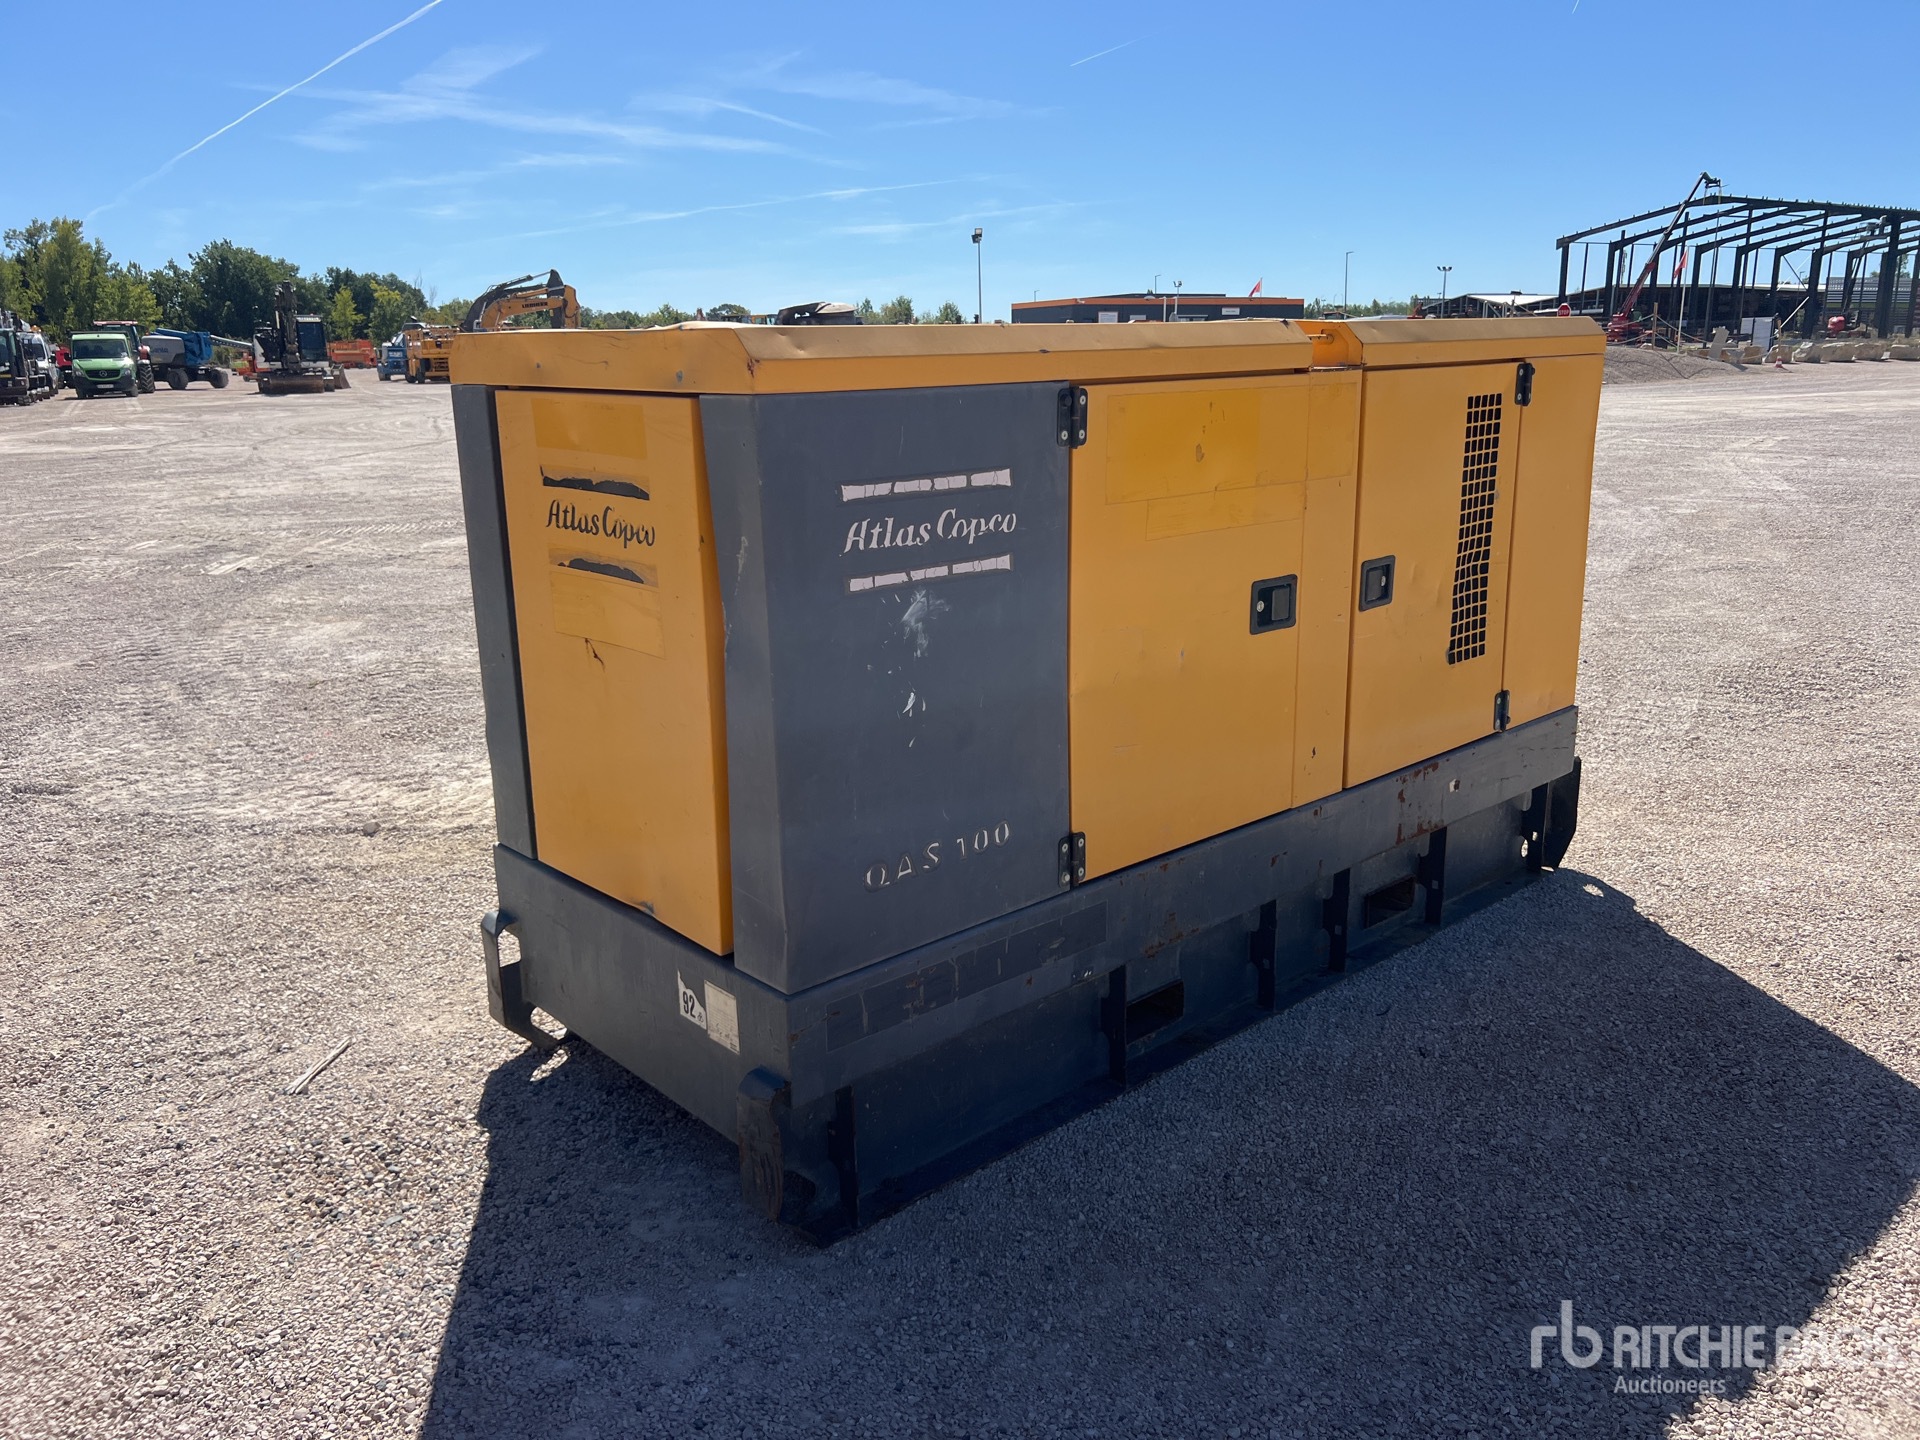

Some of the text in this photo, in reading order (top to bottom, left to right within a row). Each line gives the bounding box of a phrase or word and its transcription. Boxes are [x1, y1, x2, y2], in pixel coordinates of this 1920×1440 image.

[546, 499, 656, 549] Atlas Copco
[840, 508, 1017, 556] Atlas Copco
[956, 821, 1010, 860] 100
[682, 990, 696, 1019] 92
